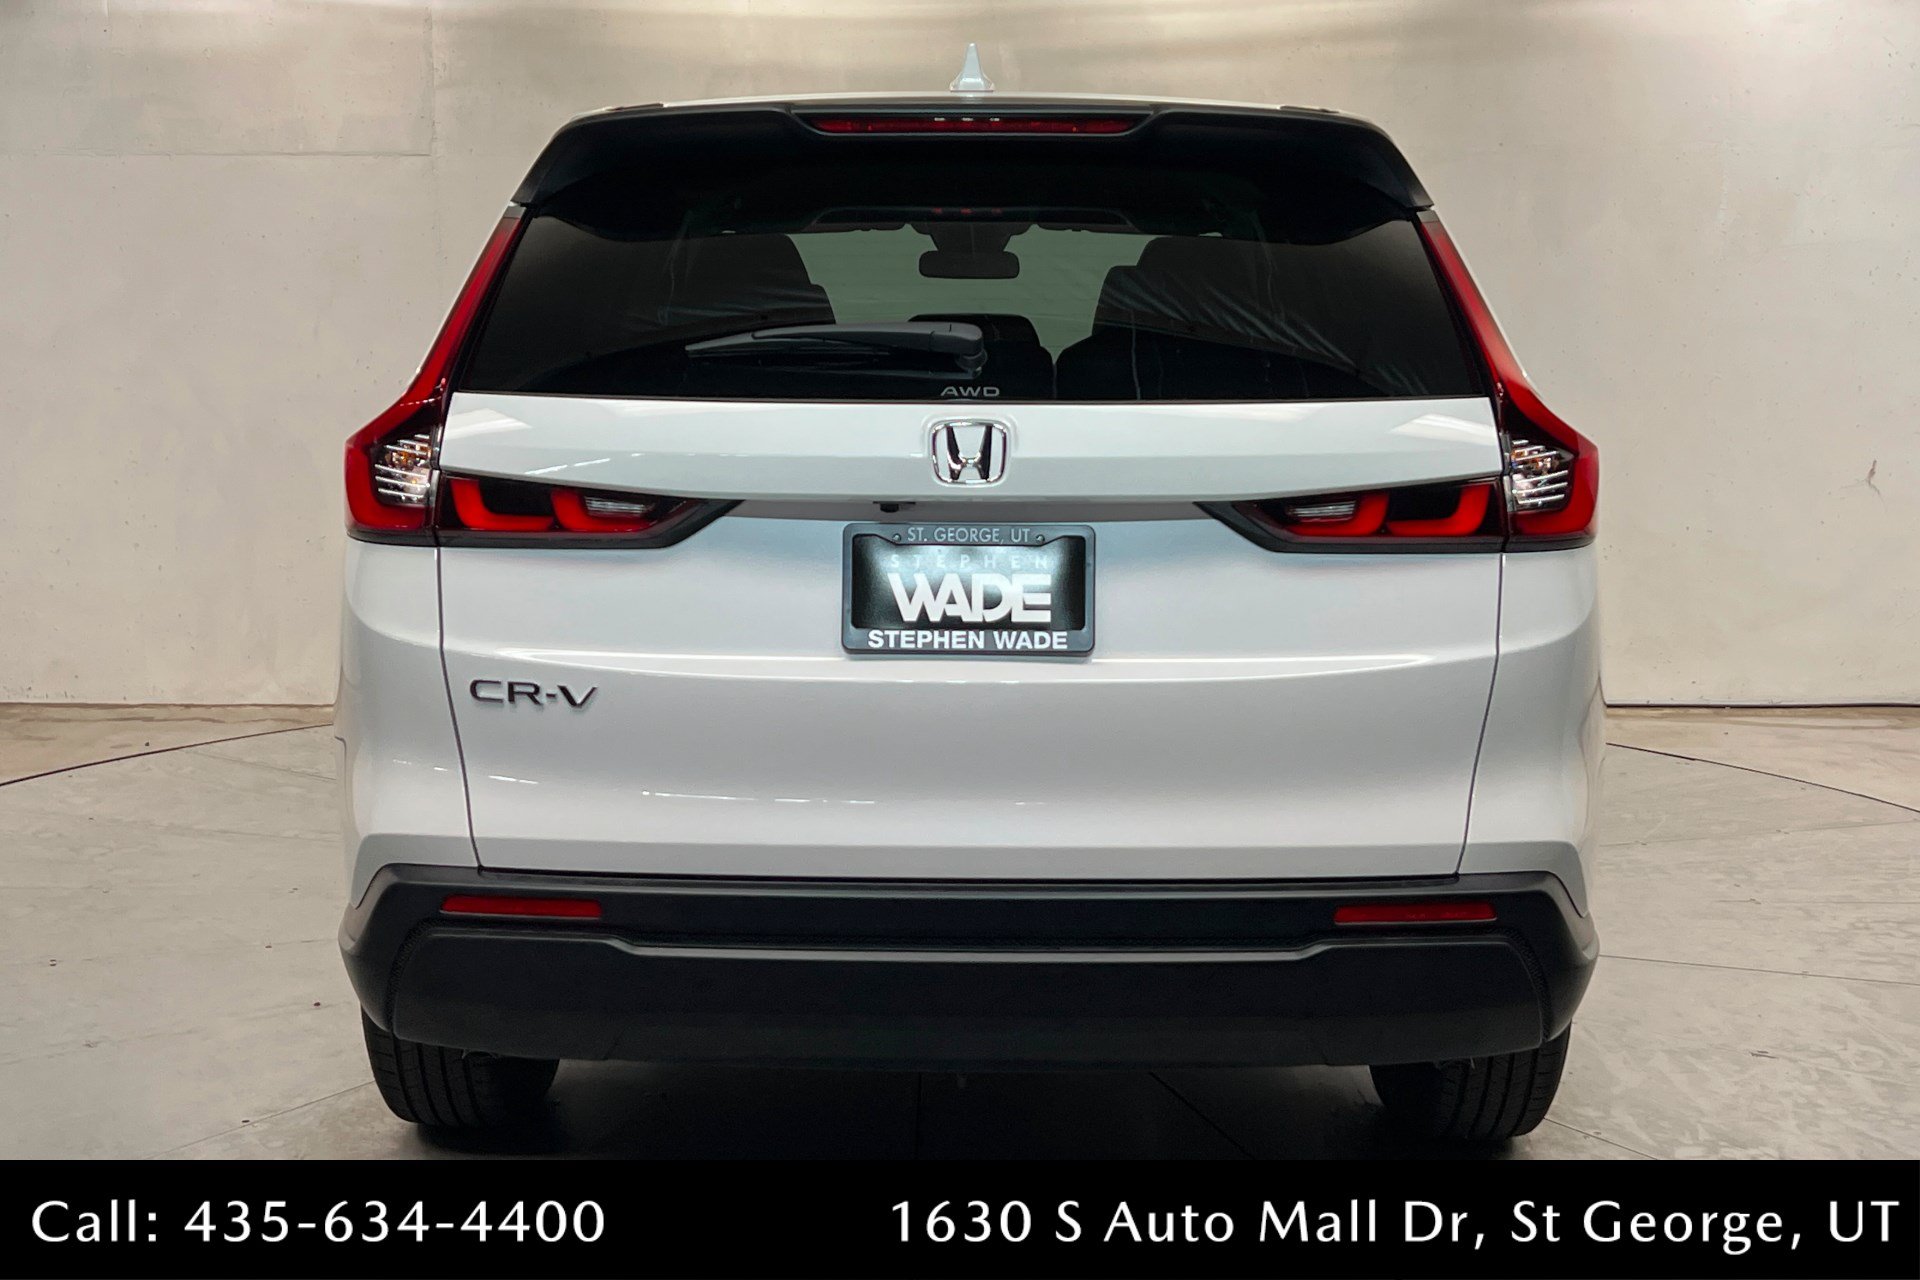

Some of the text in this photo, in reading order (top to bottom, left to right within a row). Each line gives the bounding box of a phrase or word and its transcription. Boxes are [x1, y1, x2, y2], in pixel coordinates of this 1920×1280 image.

[940, 386, 1001, 397] AWD
[907, 527, 1030, 545] ST. GEORGE, UT
[890, 554, 1049, 570] STEPHEN
[887, 572, 1052, 623] WADE
[868, 630, 1068, 650] STEPHEN WADE
[470, 679, 598, 707] CR-V
